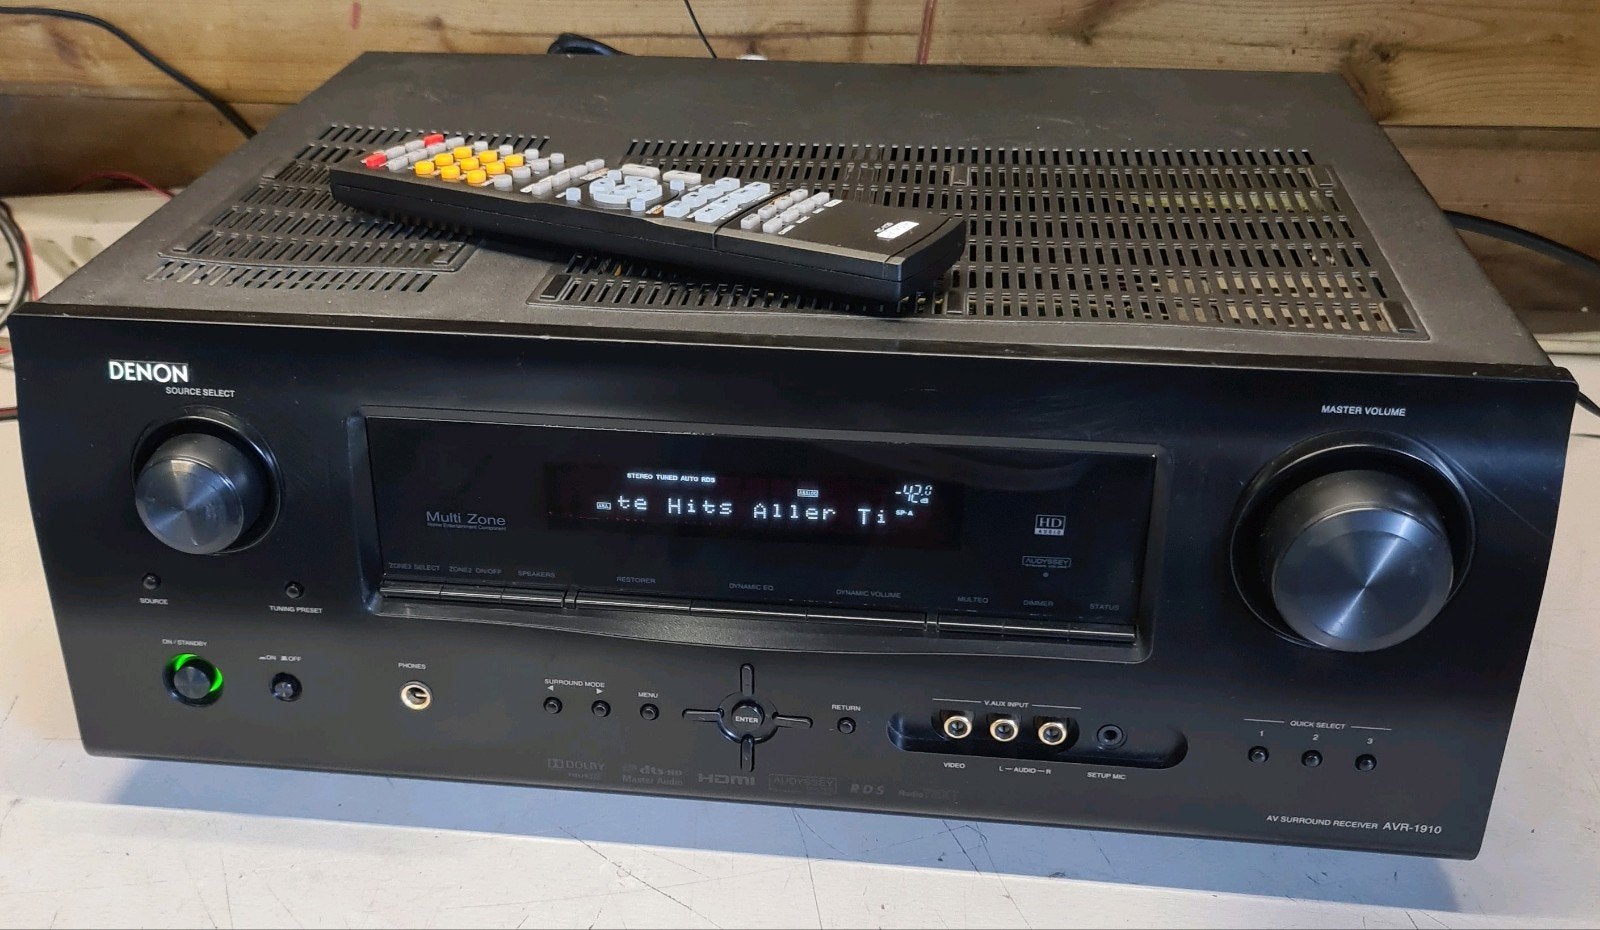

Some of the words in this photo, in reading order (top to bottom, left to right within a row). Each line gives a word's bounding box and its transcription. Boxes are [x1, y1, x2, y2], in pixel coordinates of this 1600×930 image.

[108, 361, 189, 383] DENON
[165, 386, 202, 396] SOURCE
[202, 389, 236, 398] SELECT
[1321, 405, 1362, 415] MASTER
[1364, 407, 1407, 417] VOLUME
[626, 472, 653, 480] STEREO
[617, 495, 648, 511] te
[667, 498, 733, 516] Hits
[752, 503, 837, 520] Aller
[857, 508, 886, 525] Ti
[426, 511, 462, 524] Multi
[467, 513, 507, 526] Zone
[1039, 517, 1063, 528] HD
[517, 570, 556, 578] SPEAKERS
[616, 576, 656, 584] RESTORER
[729, 583, 762, 591] DYNAMIC
[836, 589, 869, 597] DYNAMIC
[870, 591, 901, 599] VOLUME
[1089, 603, 1120, 611] STATUS
[398, 662, 427, 670] PHONES
[544, 678, 583, 687] SURROUND
[637, 691, 659, 699] MENU
[831, 704, 861, 712] RETURN
[735, 715, 759, 724] ENTER
[1289, 720, 1314, 728] QUICK
[1315, 722, 1346, 730] SELECT
[1312, 733, 1319, 741] 2
[1366, 737, 1374, 745] 3
[943, 761, 966, 769] VIDEO
[1087, 771, 1111, 779] SETUP
[698, 773, 756, 786] HDMI
[1266, 815, 1280, 823] AV
[1280, 816, 1331, 827] SURROUND
[1332, 820, 1378, 830] RECEIVER
[1382, 821, 1443, 835] AVR-1910
